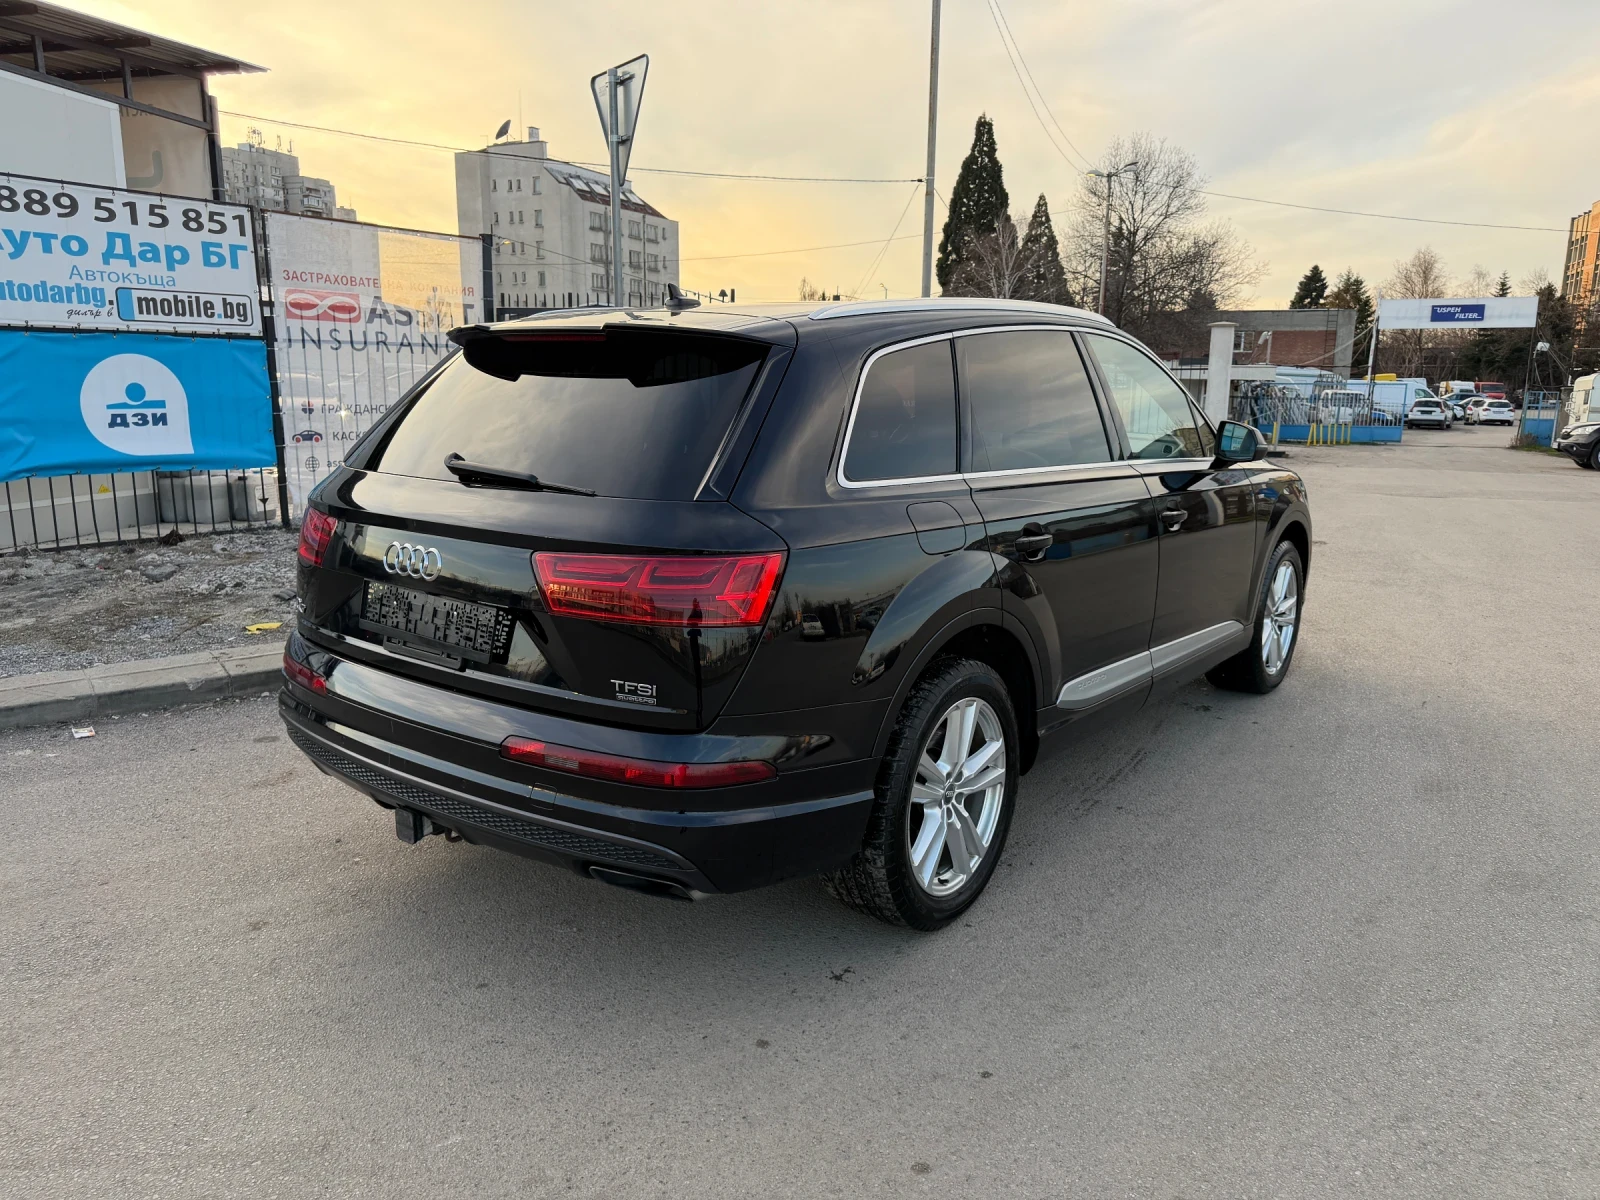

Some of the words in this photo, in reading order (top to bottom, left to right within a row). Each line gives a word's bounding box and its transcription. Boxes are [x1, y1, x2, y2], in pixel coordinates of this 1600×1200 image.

[94, 197, 170, 229] 515
[182, 208, 247, 237] 851
[0, 228, 89, 260] уто
[101, 231, 190, 271] Дар
[201, 241, 248, 270] БГ
[69, 264, 176, 288] Автокъща
[136, 294, 248, 323] mobile.bg
[108, 412, 168, 428] ДЗИ
